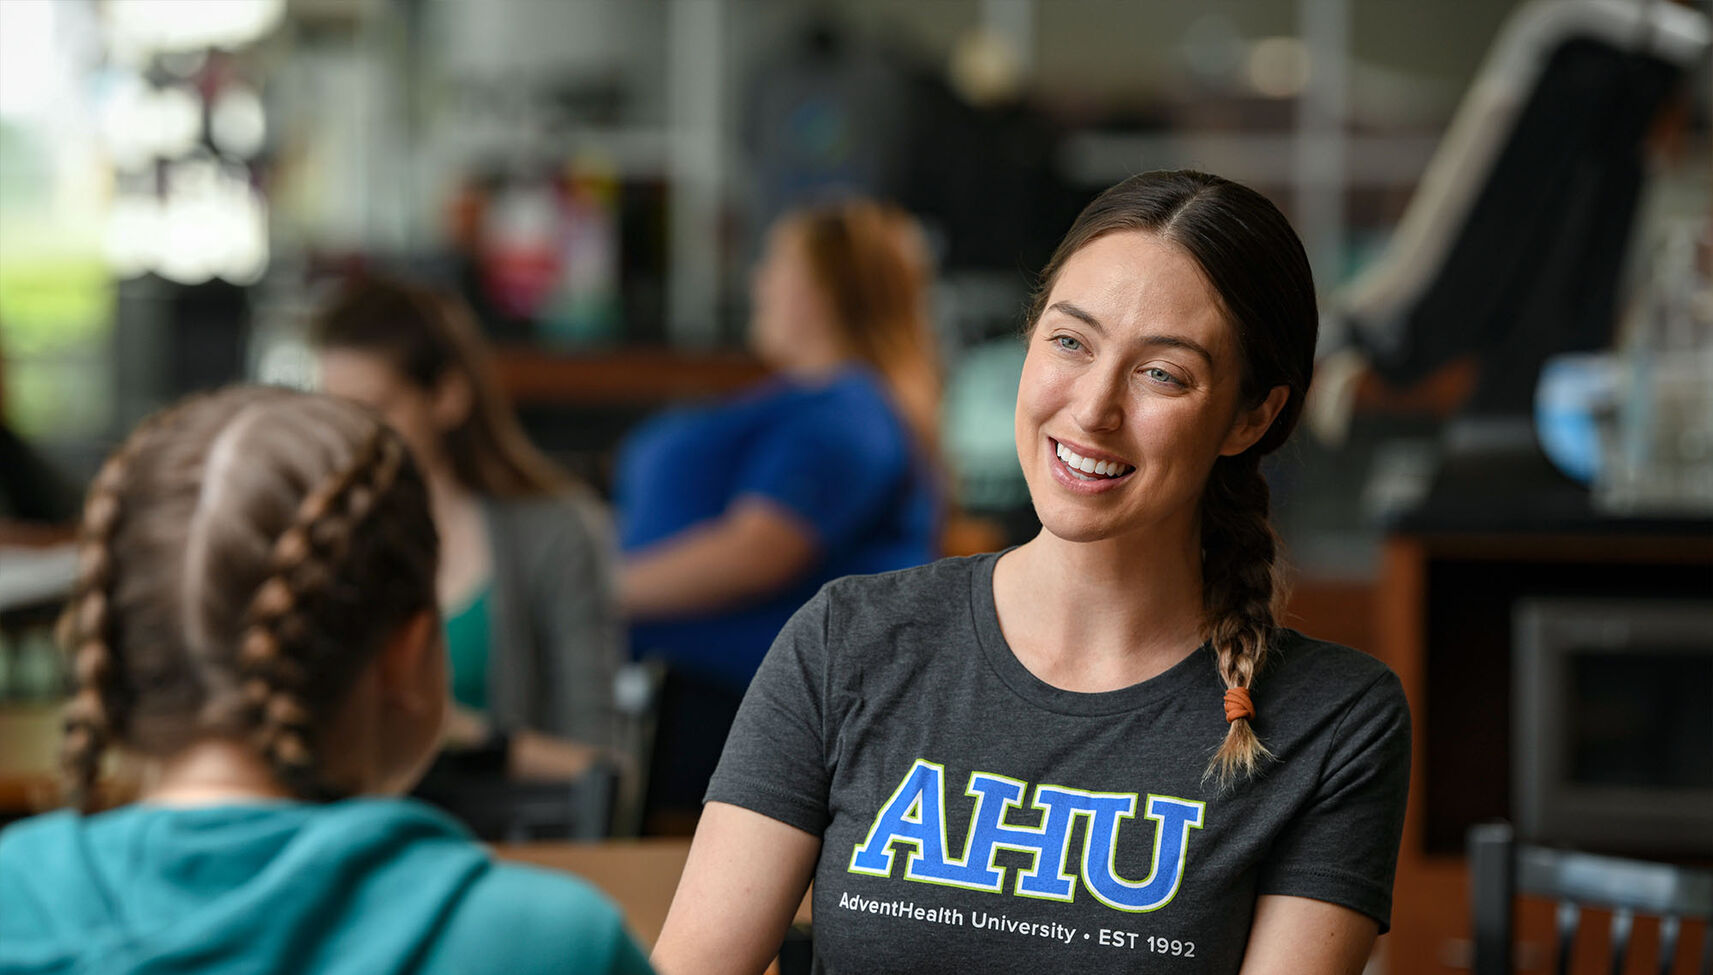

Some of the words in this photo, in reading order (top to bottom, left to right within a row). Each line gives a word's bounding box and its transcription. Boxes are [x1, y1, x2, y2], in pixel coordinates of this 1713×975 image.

[847, 758, 1206, 913] AHU
[839, 891, 964, 926] AdventHealth
[971, 911, 1076, 943] University
[1099, 928, 1139, 949] EST
[1146, 935, 1196, 958] 1992
